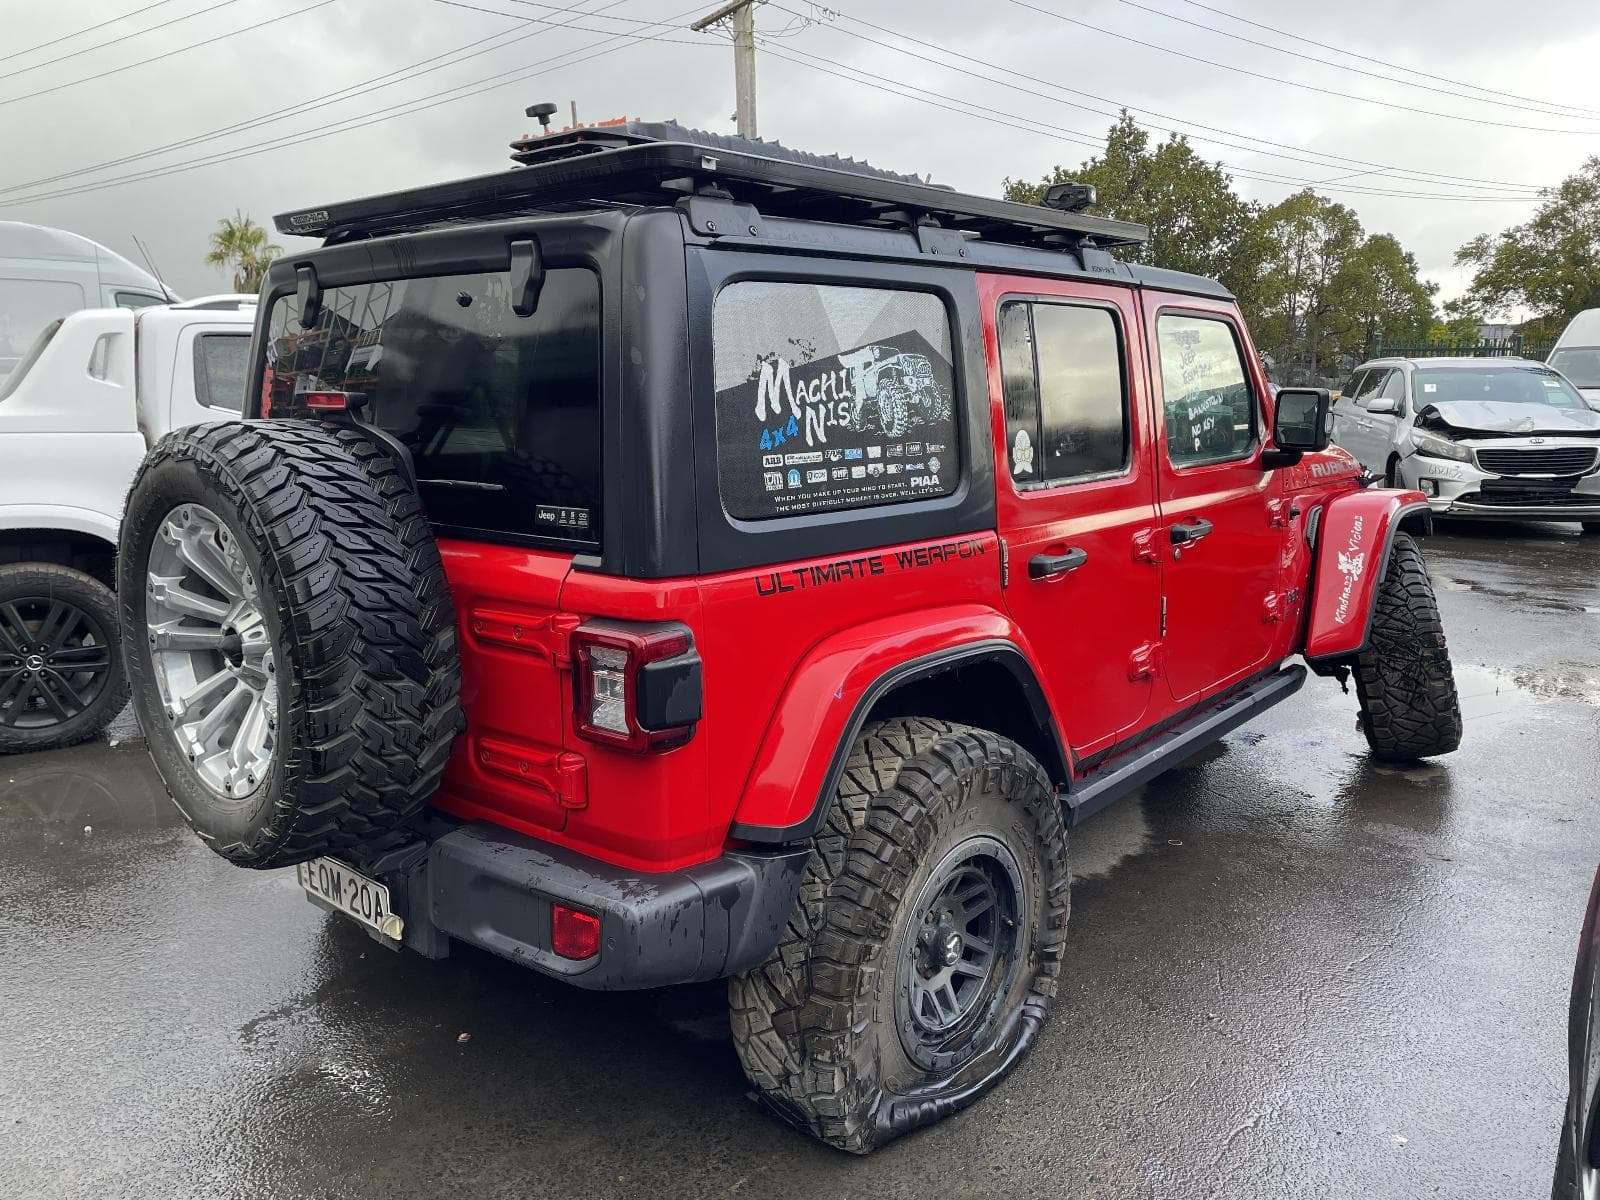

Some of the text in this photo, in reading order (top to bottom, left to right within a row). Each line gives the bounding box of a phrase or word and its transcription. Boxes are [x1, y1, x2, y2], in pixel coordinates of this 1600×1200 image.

[1203, 416, 1215, 432] KEY
[910, 475, 940, 487] PIAA
[774, 495, 796, 503] WHEN
[813, 490, 832, 498] MAKE
[791, 502, 810, 510] MOST
[812, 498, 844, 508] DIFFICULT
[845, 495, 871, 503] MOMENT
[538, 509, 556, 522] Jeep
[755, 537, 985, 597] ULTIMATE WEAPON
